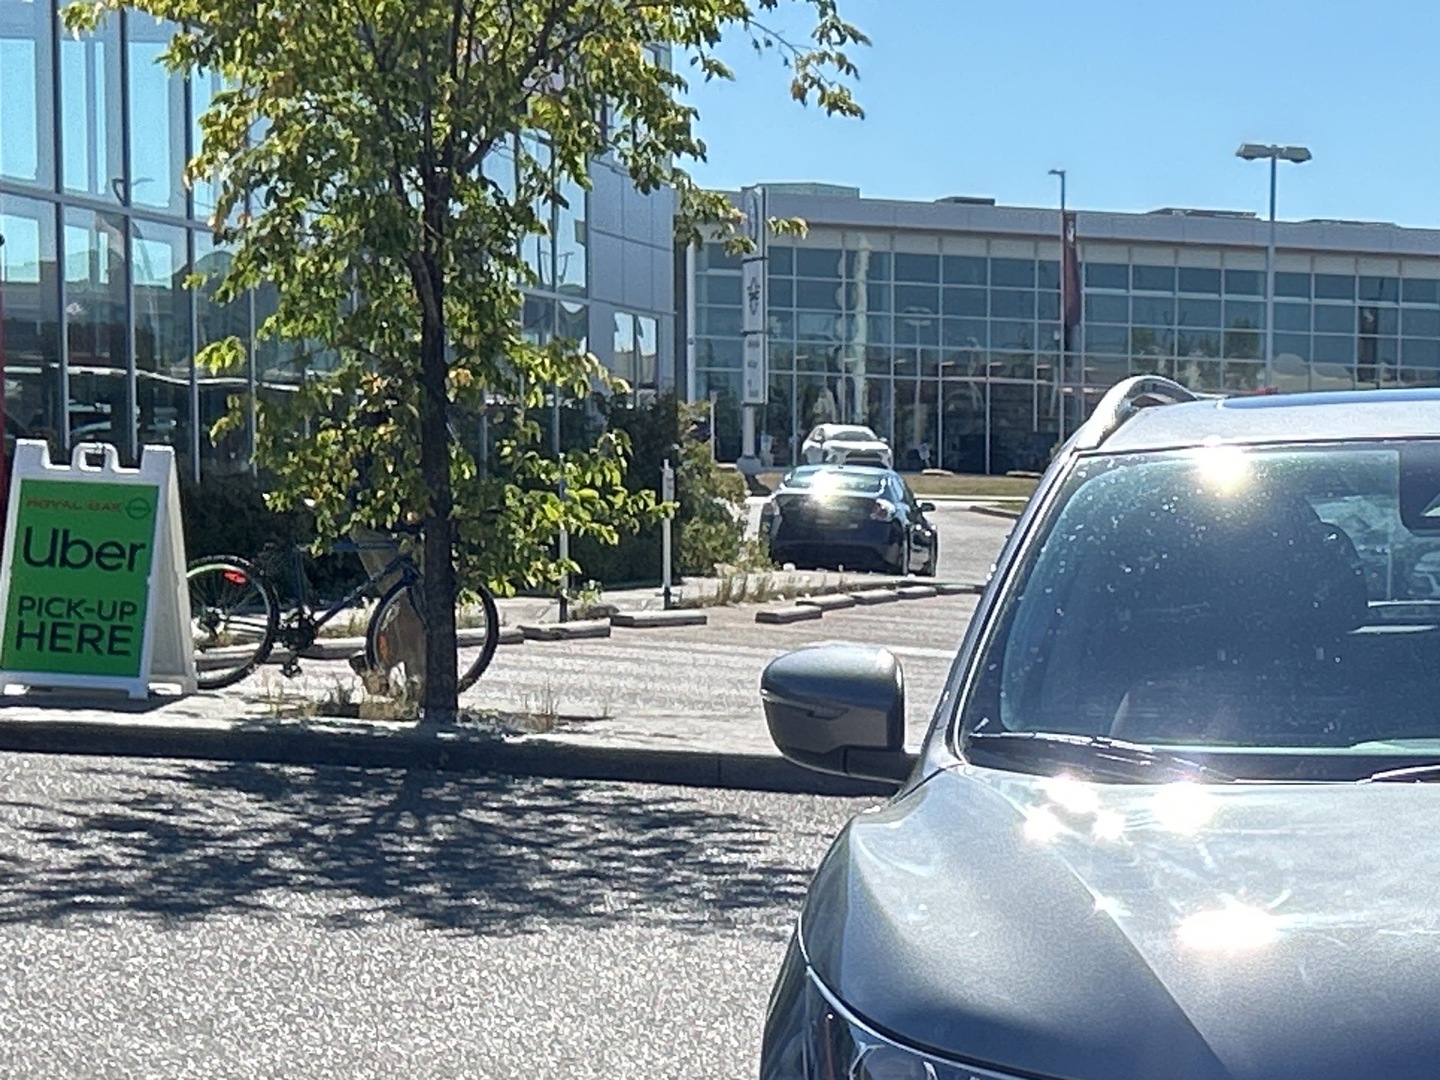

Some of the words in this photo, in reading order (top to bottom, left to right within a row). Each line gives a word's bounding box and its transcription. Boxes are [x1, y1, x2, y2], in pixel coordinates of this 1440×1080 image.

[26, 499, 82, 511] ROYAL
[23, 526, 146, 573] Uber
[17, 596, 138, 622] PICK-UP
[16, 620, 134, 657] HERE
